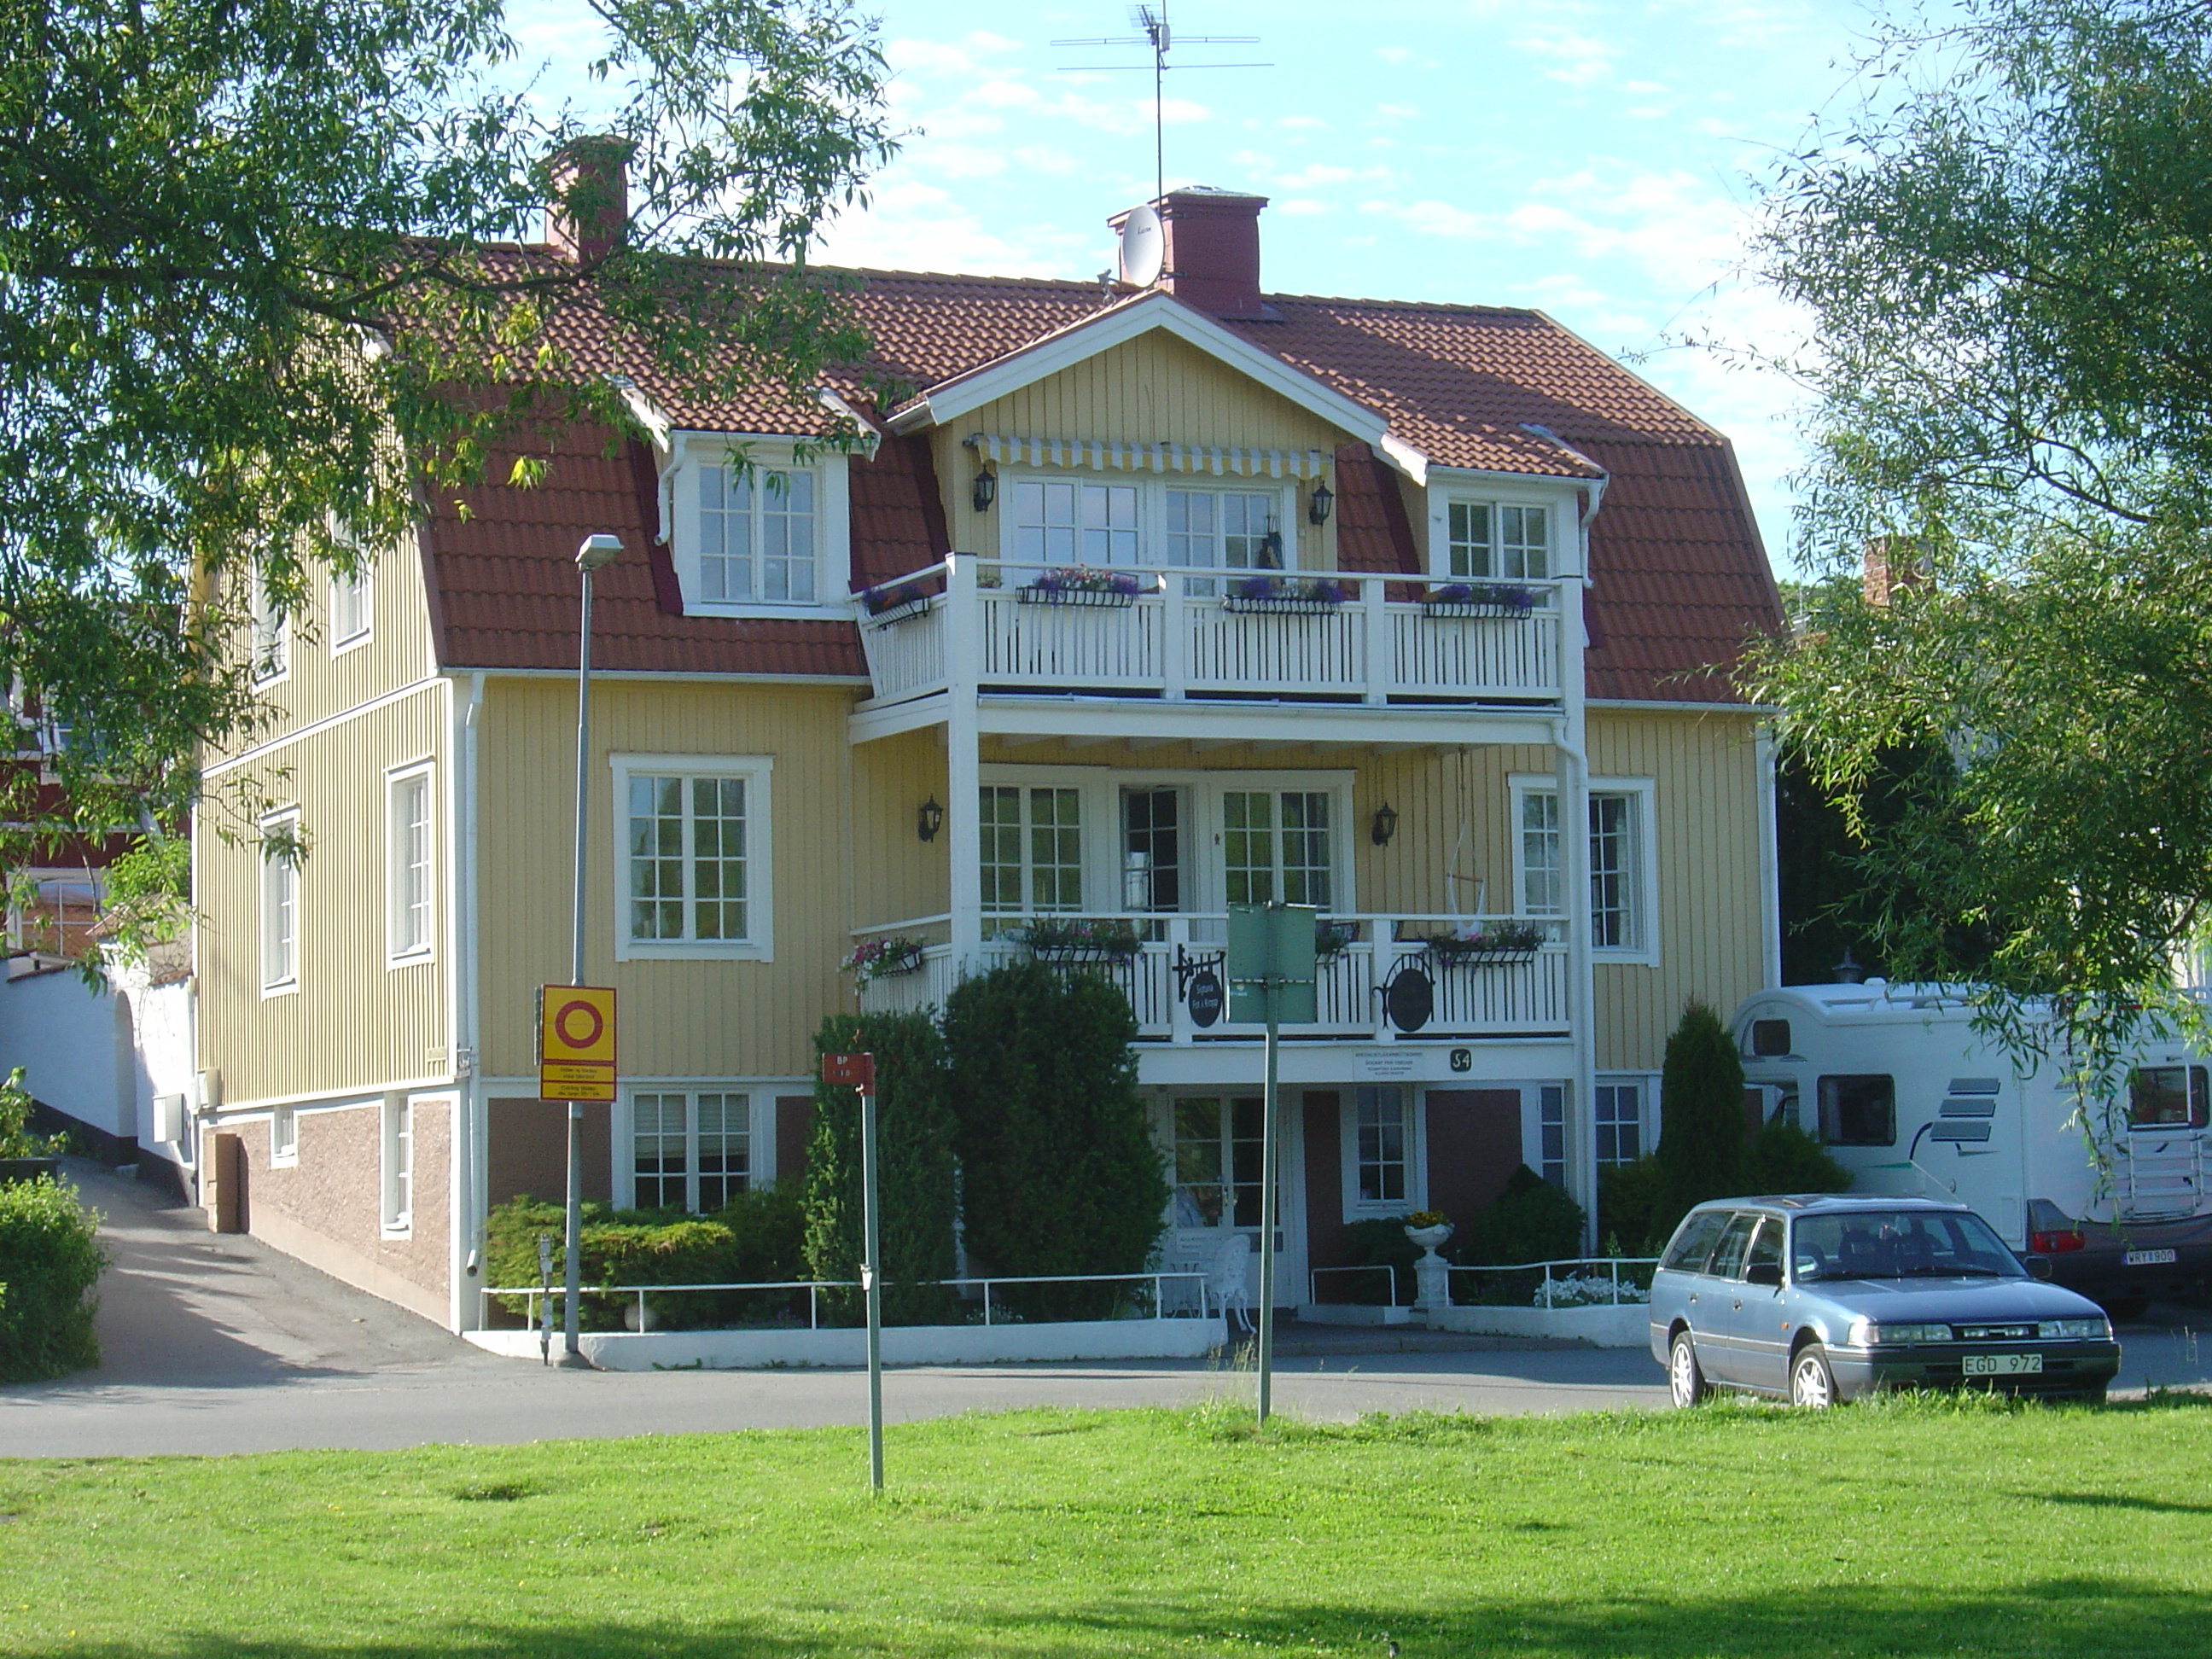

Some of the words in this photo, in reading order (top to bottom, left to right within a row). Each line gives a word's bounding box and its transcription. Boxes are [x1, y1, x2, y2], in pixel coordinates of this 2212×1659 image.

[837, 1056, 848, 1065] BP
[2128, 1250, 2148, 1264] WRY
[2154, 1249, 2174, 1262] 900
[1965, 1357, 1997, 1372] EGD
[2010, 1356, 2040, 1371] 972
